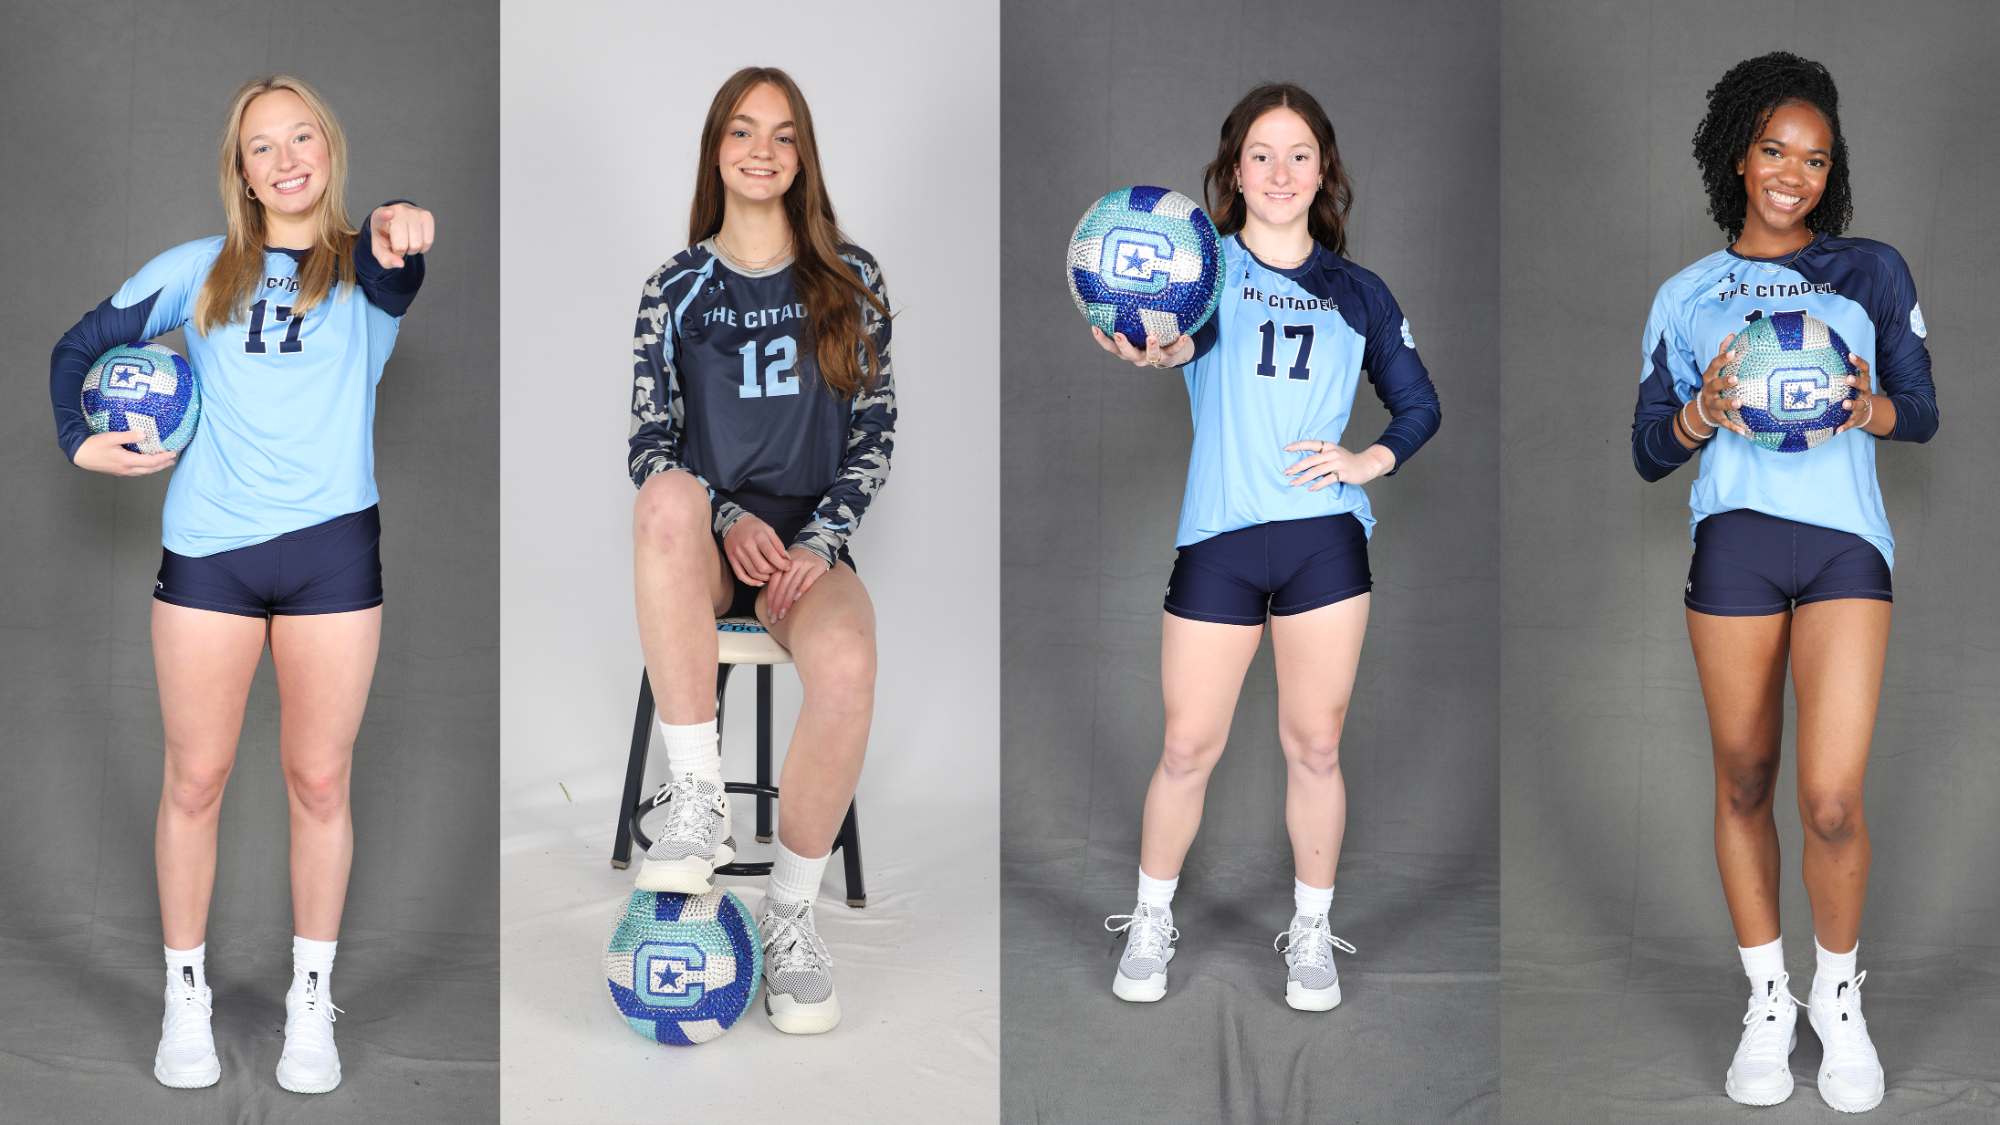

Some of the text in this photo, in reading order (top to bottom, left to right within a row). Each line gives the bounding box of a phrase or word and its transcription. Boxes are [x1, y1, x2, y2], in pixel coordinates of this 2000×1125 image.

[266, 276, 300, 293] CITA
[1717, 281, 1837, 302] THE CITADEL
[1242, 286, 1339, 312] HE CITADEL
[243, 298, 304, 354] 17
[702, 303, 809, 329] THE CITAD
[1255, 318, 1315, 381] 17
[738, 334, 800, 399] 12
